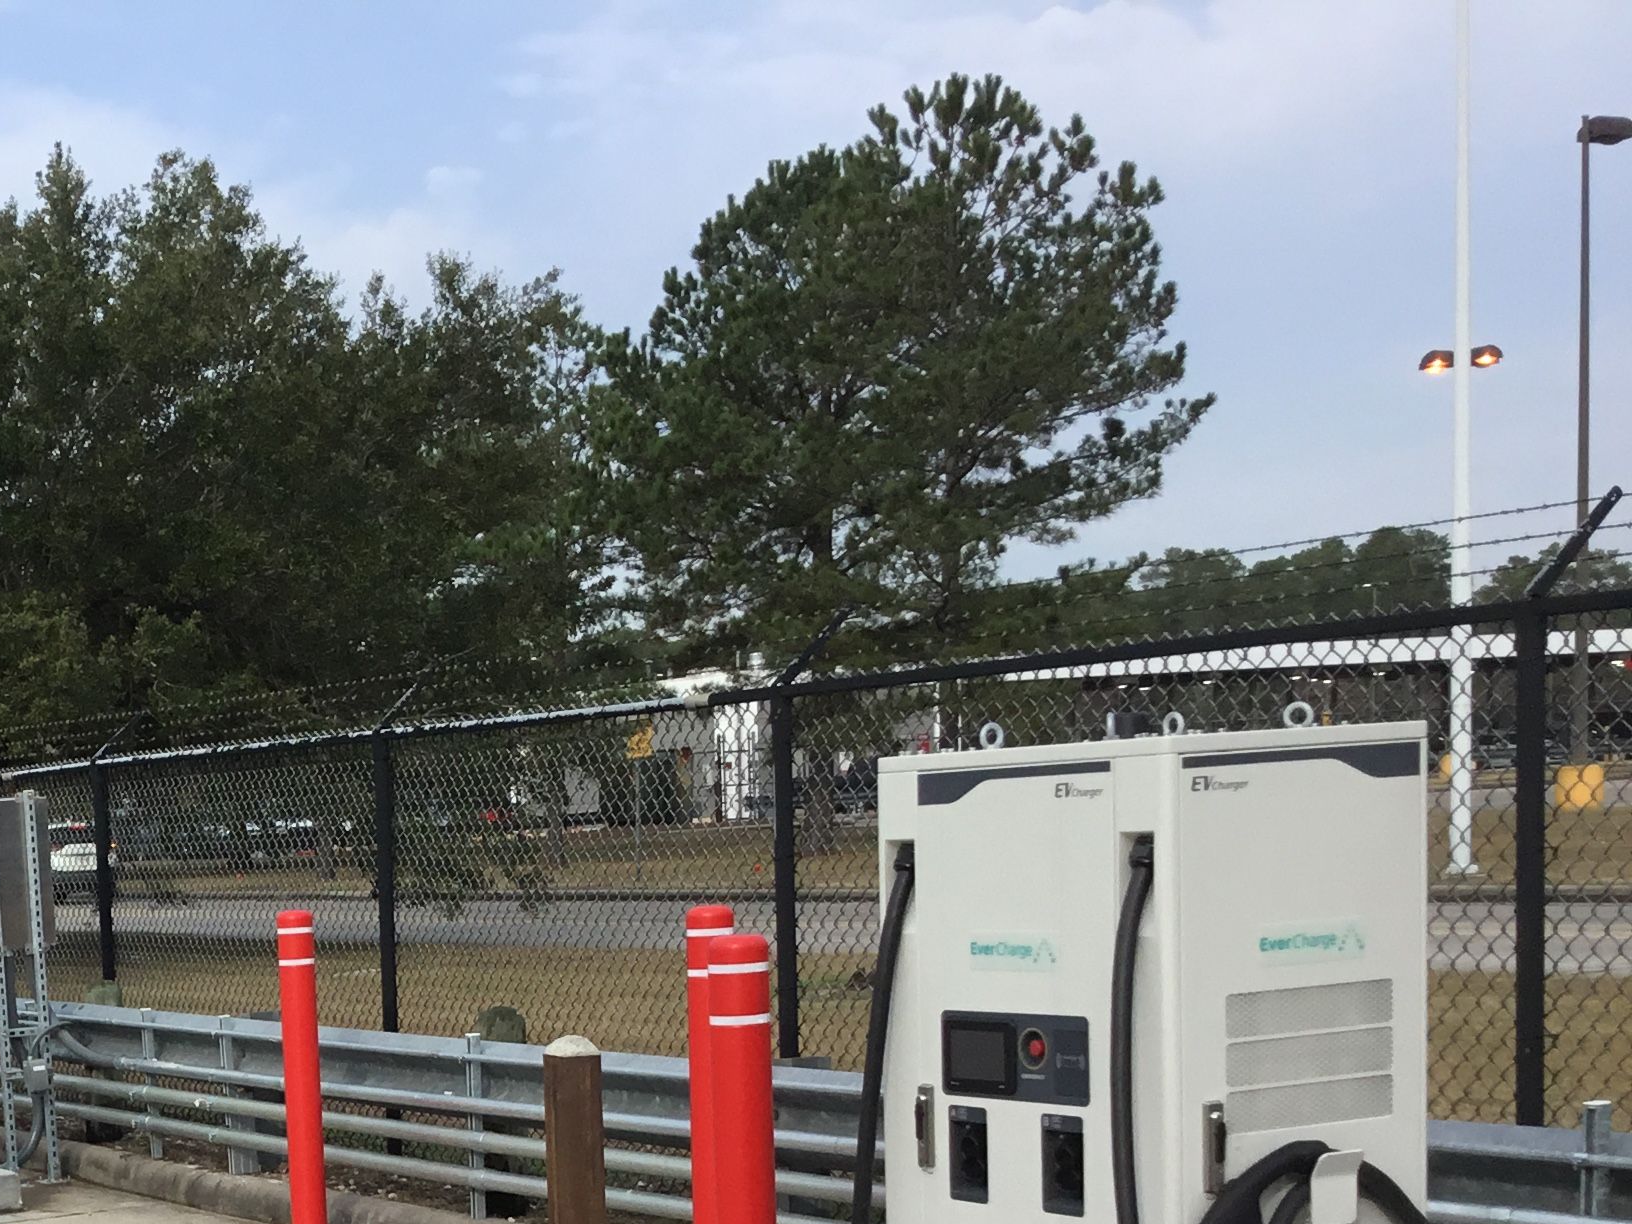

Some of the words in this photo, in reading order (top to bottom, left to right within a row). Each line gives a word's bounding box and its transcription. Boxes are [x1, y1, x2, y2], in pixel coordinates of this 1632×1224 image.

[1054, 782, 1073, 799] EV
[1072, 788, 1104, 799] Charger
[1191, 775, 1213, 792] EV
[1211, 780, 1249, 792] Charger
[970, 941, 1033, 960] EverCharge
[1258, 933, 1336, 953] EverCharge
